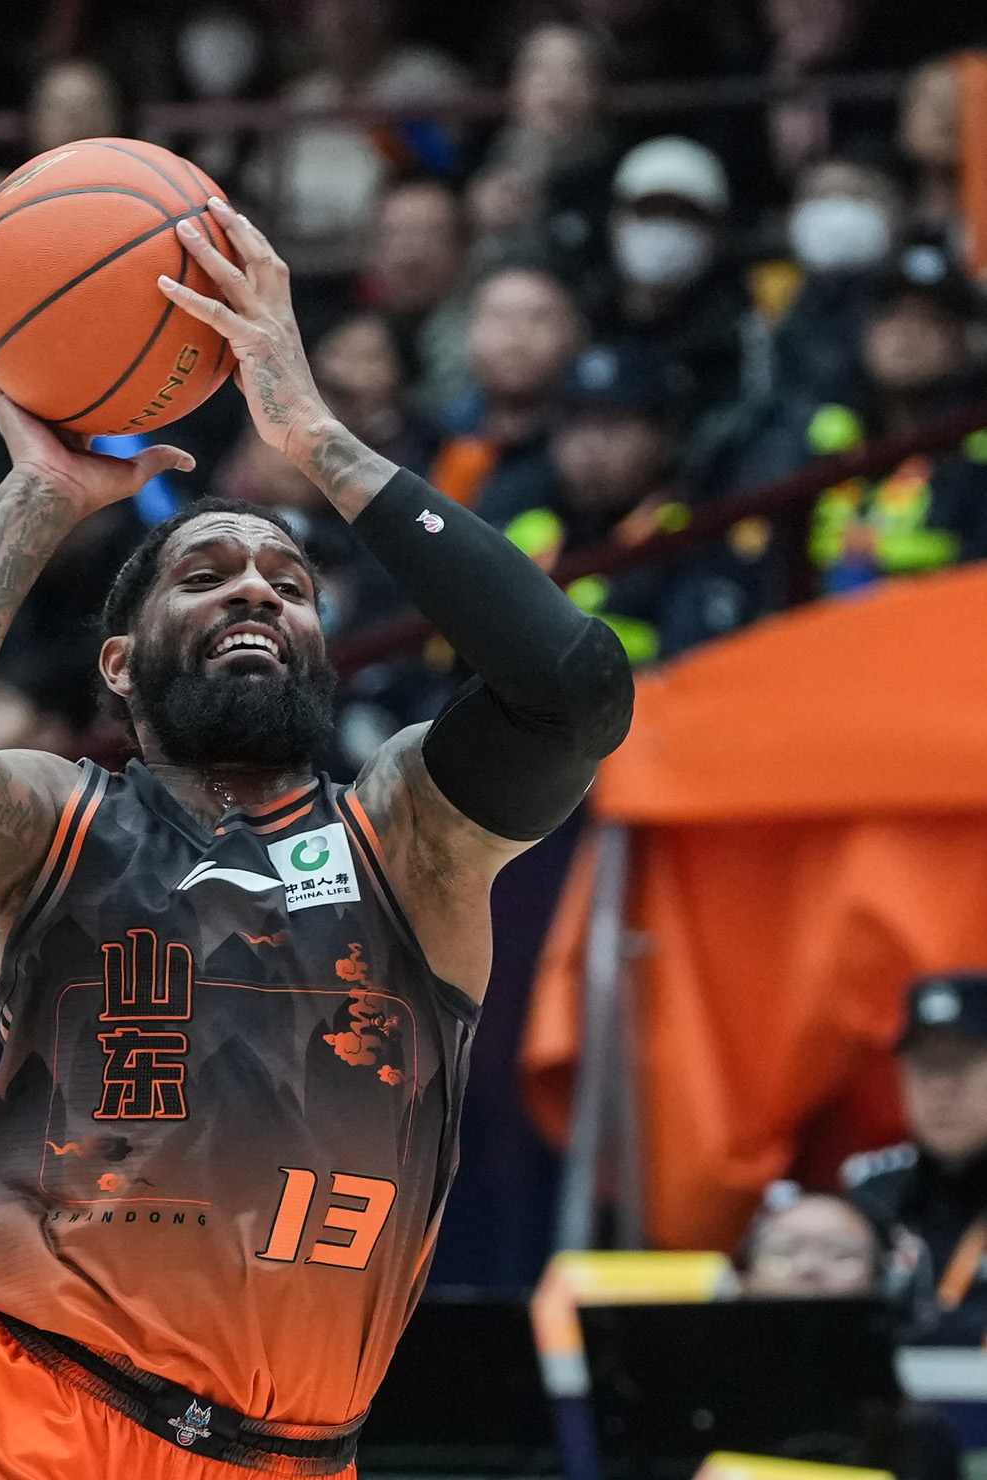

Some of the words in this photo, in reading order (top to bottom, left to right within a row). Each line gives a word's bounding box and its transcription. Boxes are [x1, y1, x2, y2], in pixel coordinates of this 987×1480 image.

[285, 873, 349, 894] 中国人寿
[287, 891, 323, 903] CHINA
[327, 887, 351, 895] LIFE
[93, 928, 193, 1120] 山东
[51, 1211, 206, 1226] SHANDONG
[255, 1166, 397, 1270] 13
